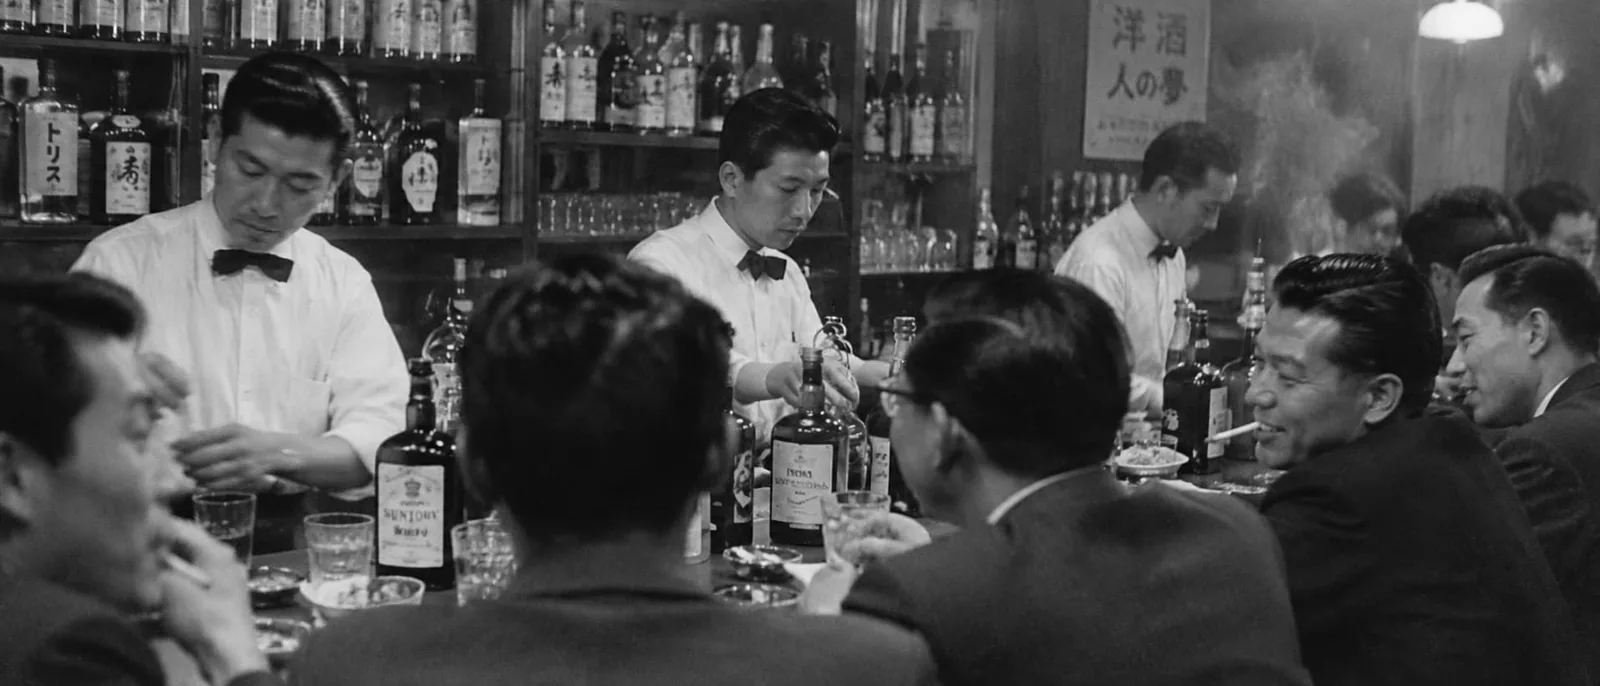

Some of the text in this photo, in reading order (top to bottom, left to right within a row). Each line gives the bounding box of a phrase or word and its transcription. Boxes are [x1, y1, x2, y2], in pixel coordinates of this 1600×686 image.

[1112, 5, 1187, 56] 洋酒
[46, 122, 61, 182] トリス
